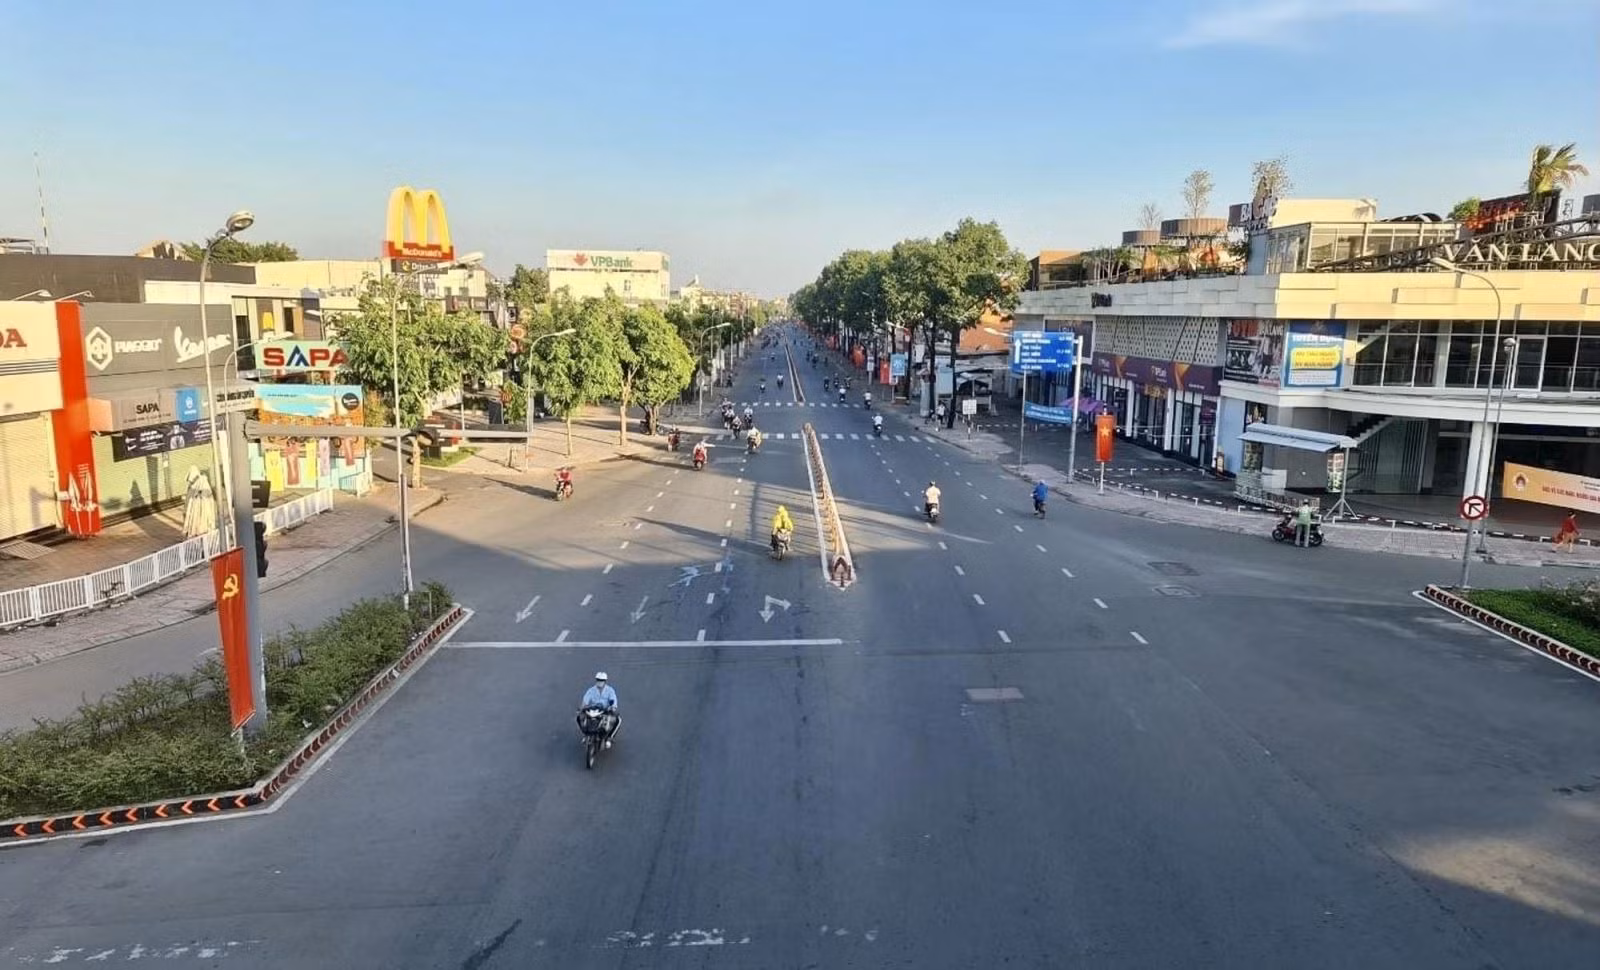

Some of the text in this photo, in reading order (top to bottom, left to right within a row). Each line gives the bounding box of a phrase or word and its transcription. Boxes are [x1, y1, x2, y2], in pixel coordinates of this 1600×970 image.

[591, 255, 633, 268] VPBank
[263, 345, 349, 367] SAPA
[136, 403, 159, 415] SAPA
